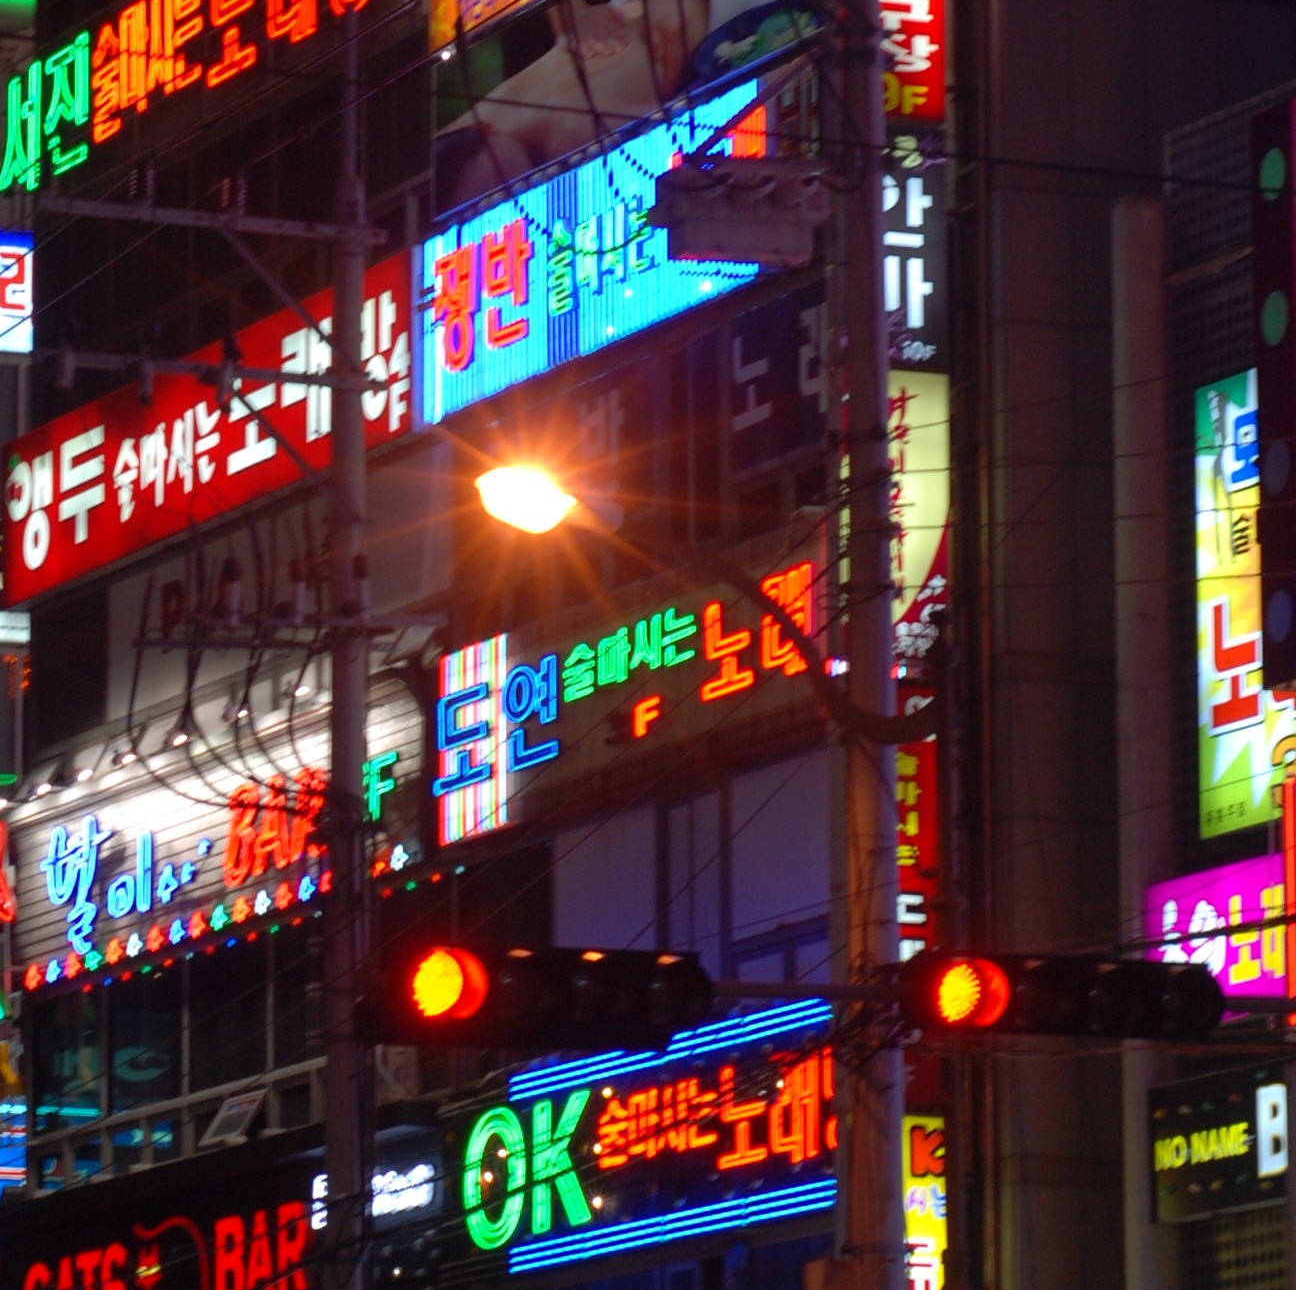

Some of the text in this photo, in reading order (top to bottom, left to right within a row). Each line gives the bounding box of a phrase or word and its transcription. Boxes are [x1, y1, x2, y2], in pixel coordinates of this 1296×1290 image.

[6, 424, 105, 571] 앵두
[112, 399, 222, 524] 술마시는
[561, 607, 698, 703] 술마시는
[464, 1088, 593, 1251] OK
[1154, 1121, 1250, 1182] NO NAME
